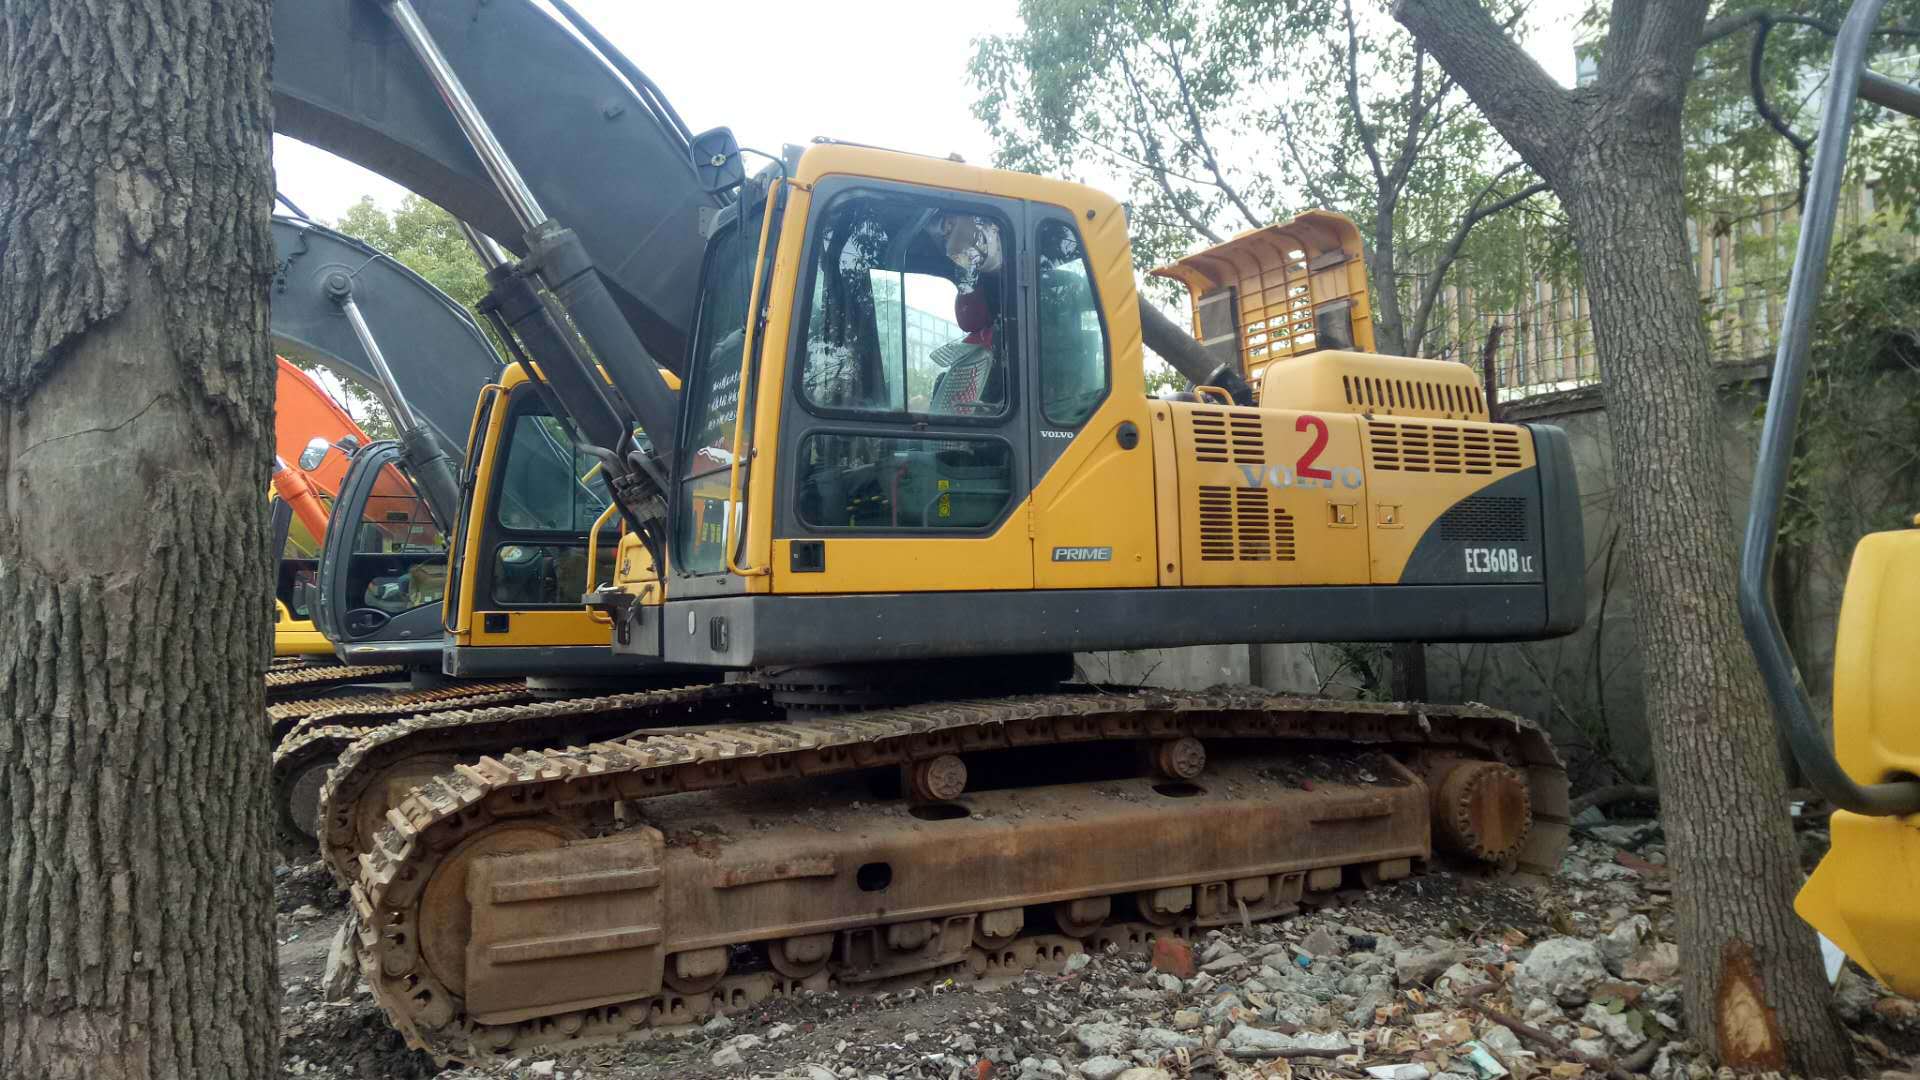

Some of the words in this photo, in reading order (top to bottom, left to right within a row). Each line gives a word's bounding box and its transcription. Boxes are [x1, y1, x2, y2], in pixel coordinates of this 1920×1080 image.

[1040, 430, 1075, 439] VOLVO
[1295, 415, 1332, 480] 2
[1237, 464, 1362, 489] VOO
[1055, 548, 1110, 560] PRIME
[1464, 548, 1519, 573] EC360B
[1521, 555, 1534, 573] LC
